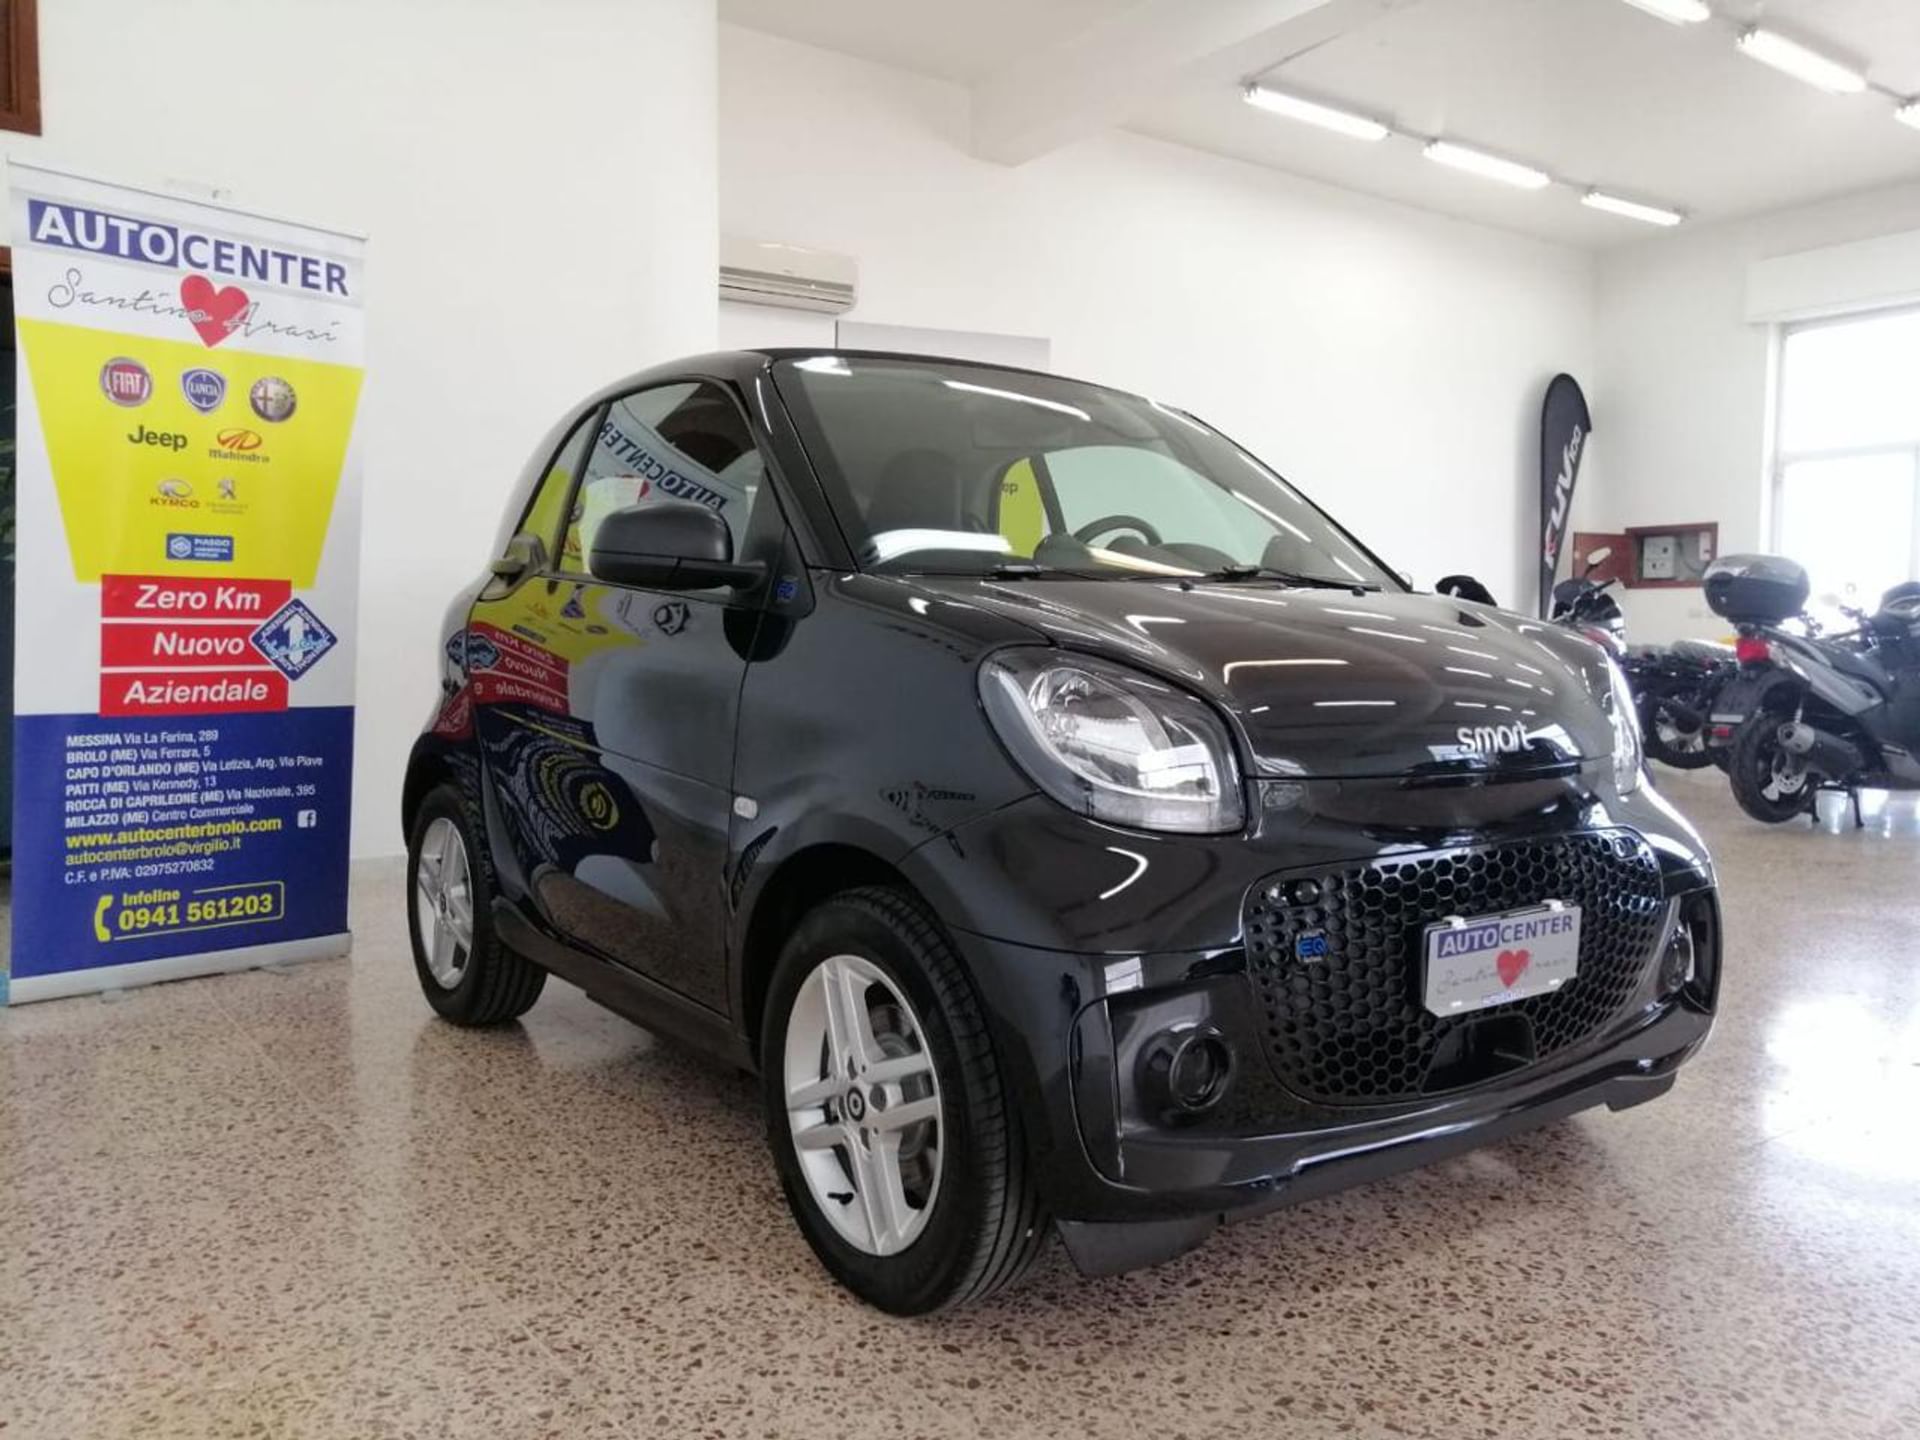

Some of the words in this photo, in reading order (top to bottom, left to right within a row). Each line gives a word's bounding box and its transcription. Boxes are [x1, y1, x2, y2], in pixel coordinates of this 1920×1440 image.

[35, 205, 350, 297] AUTOCENTER
[111, 371, 143, 395] FIAT
[189, 381, 219, 396] LANCIA
[127, 424, 189, 452] Jeep
[149, 497, 201, 509] KYMCO
[134, 584, 208, 610] Zero
[213, 586, 262, 611] Km
[152, 631, 245, 657] Nuovo
[123, 679, 269, 705] Aziendale
[65, 733, 122, 748] MESSINA
[123, 732, 142, 745] Via
[144, 732, 158, 745] La
[1456, 720, 1536, 753] smart
[65, 750, 108, 765] BROLO
[110, 748, 138, 764] (ME)
[140, 748, 158, 760] Via
[65, 766, 99, 780] CAPO
[102, 762, 171, 778] D'ORLANDO
[174, 761, 200, 776] (ME)
[202, 760, 217, 772] Via
[279, 756, 295, 767] Via
[65, 783, 99, 797] PATTI
[102, 780, 130, 796] (ME)
[132, 780, 151, 792] Via
[204, 775, 217, 788] 13
[65, 798, 107, 813] ROCCA
[110, 797, 123, 809] DI
[125, 792, 199, 808] CAPRILEONE
[200, 790, 225, 805] (ME)
[226, 789, 242, 800] Via
[65, 812, 119, 828] MILAZZO
[122, 810, 149, 826] (ME)
[152, 809, 188, 822] Centro
[190, 803, 255, 819] Commerciale
[66, 818, 282, 849] www.autocenterbrolo.com
[65, 837, 242, 866] autocenterbrolo@virgilio.it
[64, 870, 87, 885] C.F.
[89, 872, 98, 882] e
[122, 889, 181, 906] Infoline
[118, 903, 180, 931] 0941
[186, 893, 273, 922] 561203
[1440, 914, 1574, 957] AUTOCENTER
